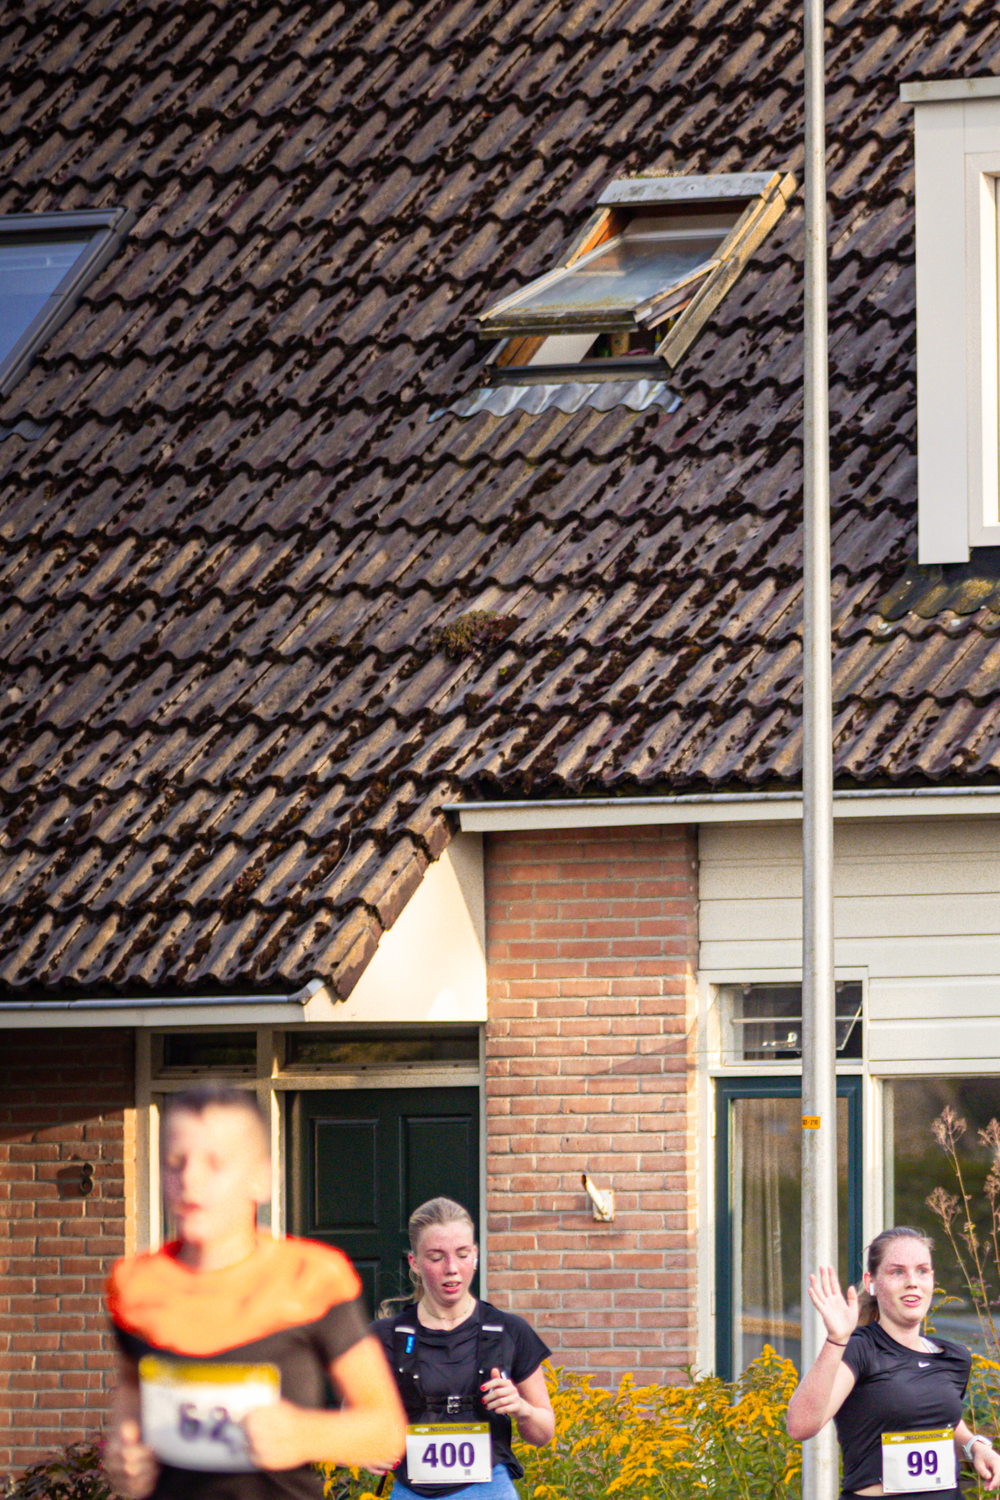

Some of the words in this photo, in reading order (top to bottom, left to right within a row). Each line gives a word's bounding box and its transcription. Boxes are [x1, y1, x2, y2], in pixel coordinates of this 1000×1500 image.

[80, 1162, 95, 1197] 8
[421, 1441, 476, 1469] 400
[906, 1449, 939, 1478] 99
